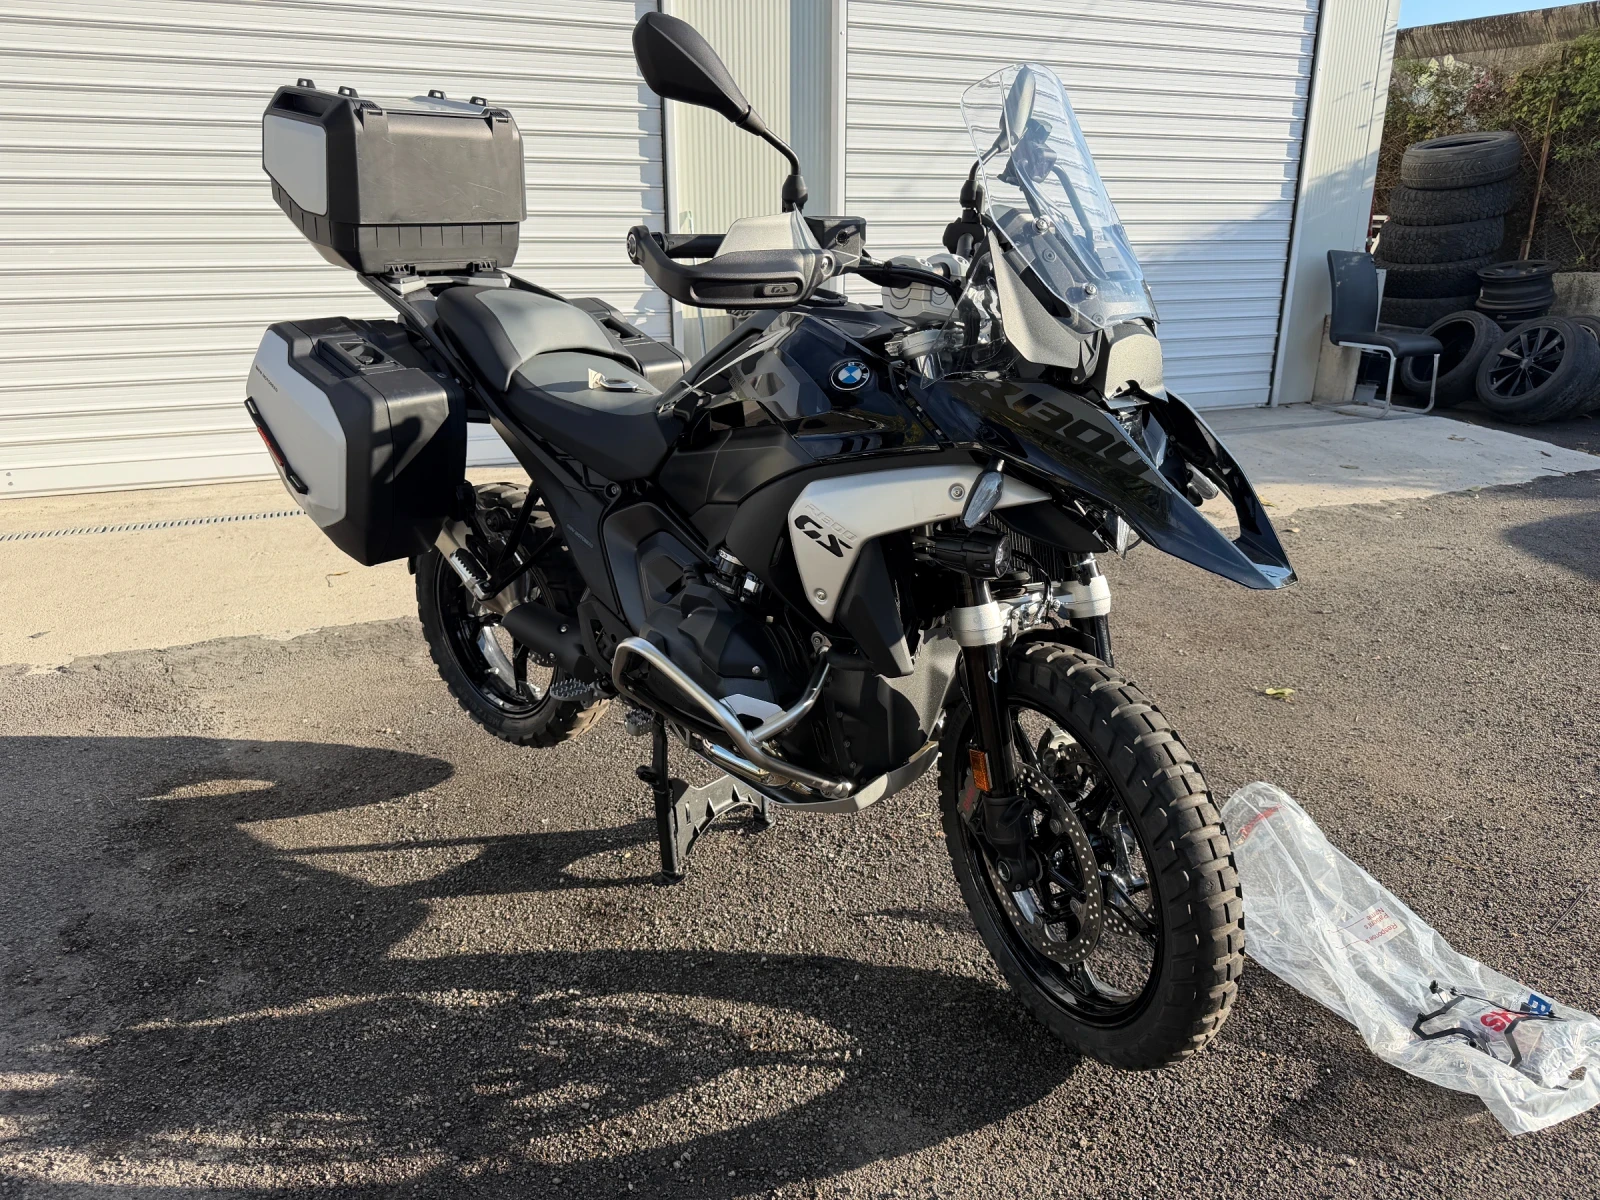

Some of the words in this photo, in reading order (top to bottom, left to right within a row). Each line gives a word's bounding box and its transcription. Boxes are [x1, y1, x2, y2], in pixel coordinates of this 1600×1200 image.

[794, 514, 853, 558] GS
[1364, 912, 1390, 930] Patient's
[1366, 907, 1385, 921] Name
[1369, 922, 1398, 941] Response
